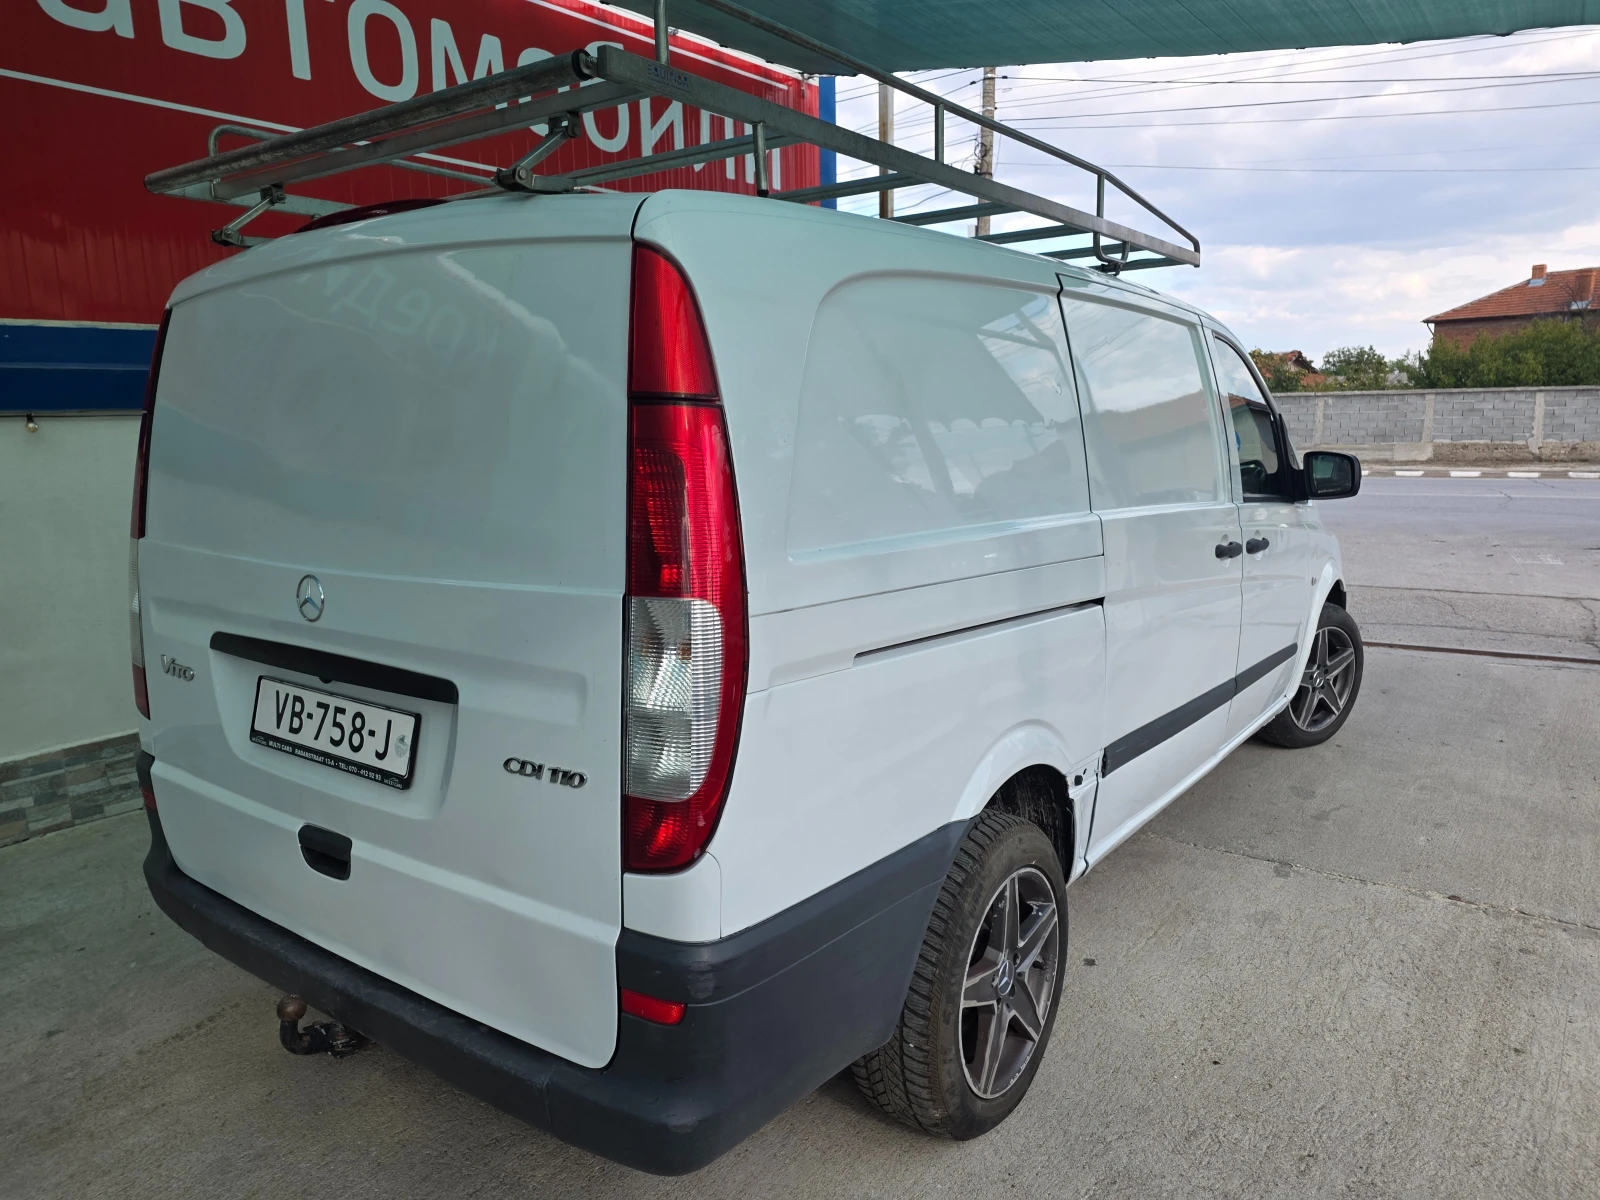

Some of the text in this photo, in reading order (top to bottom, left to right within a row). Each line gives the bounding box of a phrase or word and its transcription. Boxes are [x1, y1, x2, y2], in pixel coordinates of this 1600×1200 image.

[275, 689, 393, 761] VB-758-J
[268, 740, 281, 750] MULTI
[281, 744, 293, 753] CARS
[502, 756, 589, 790] CDI 110
